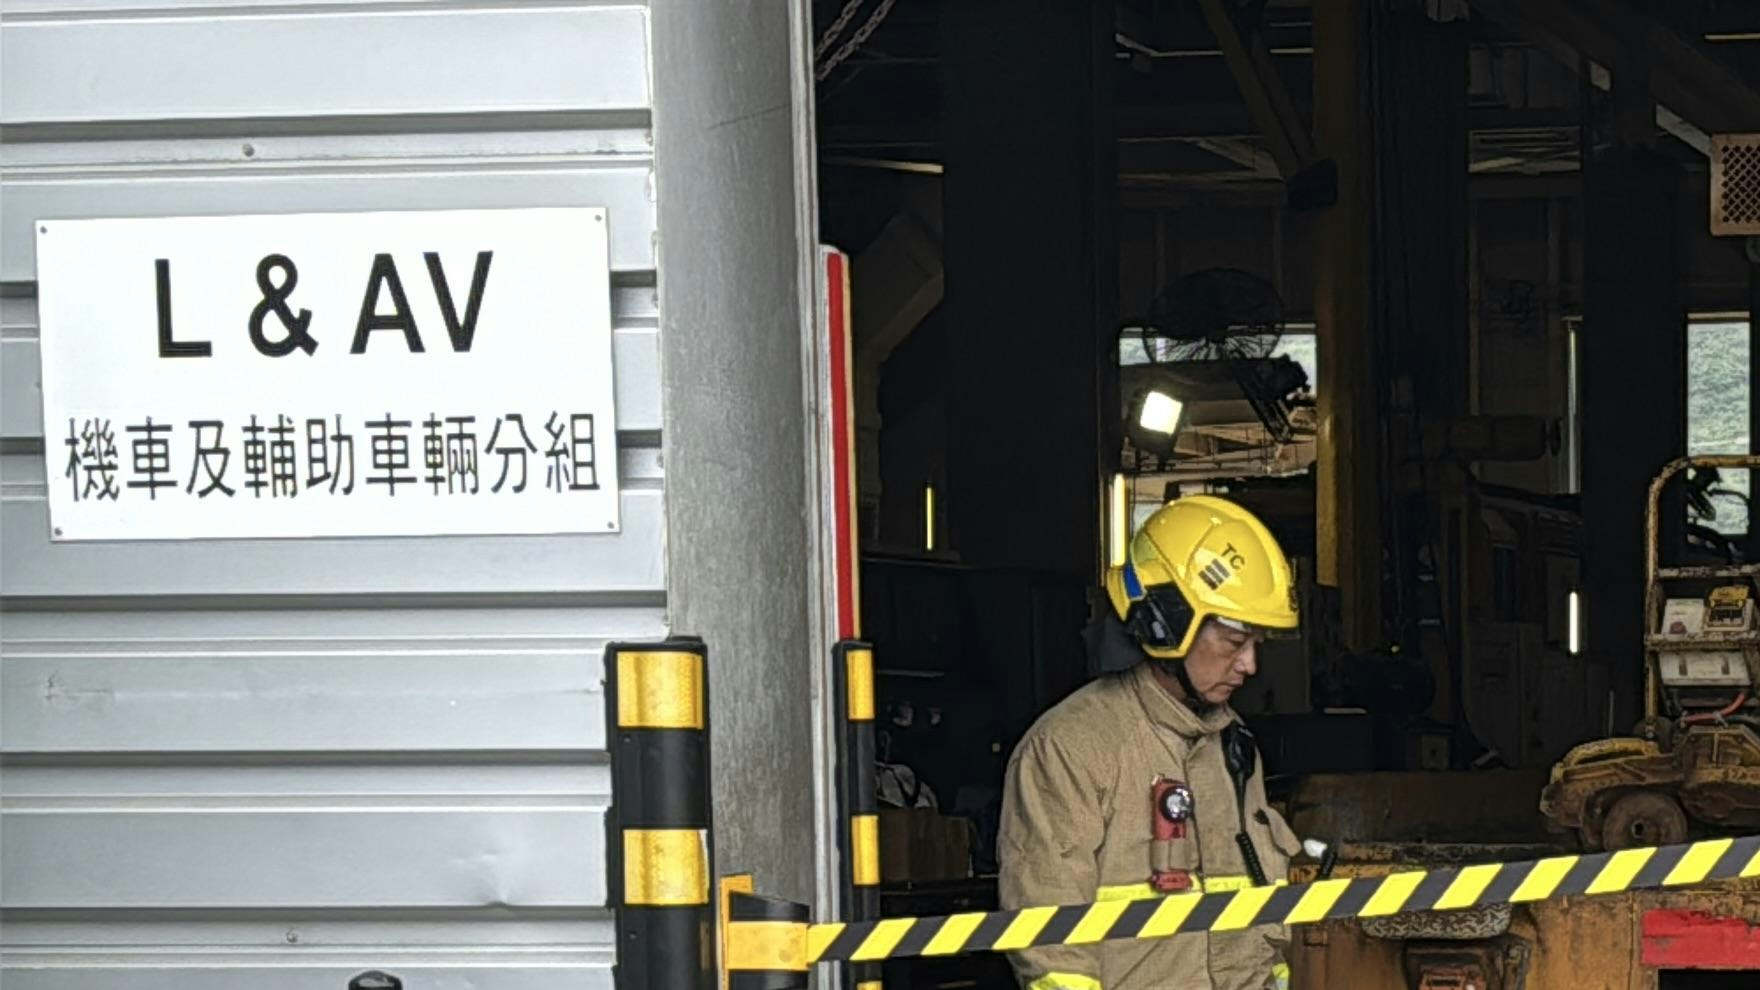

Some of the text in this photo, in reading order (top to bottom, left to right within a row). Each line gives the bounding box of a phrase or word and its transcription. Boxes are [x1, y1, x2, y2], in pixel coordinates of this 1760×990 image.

[155, 250, 494, 358] L & AV
[64, 410, 601, 502] 機車及輔助車輛分組
[1220, 543, 1246, 571] TC
